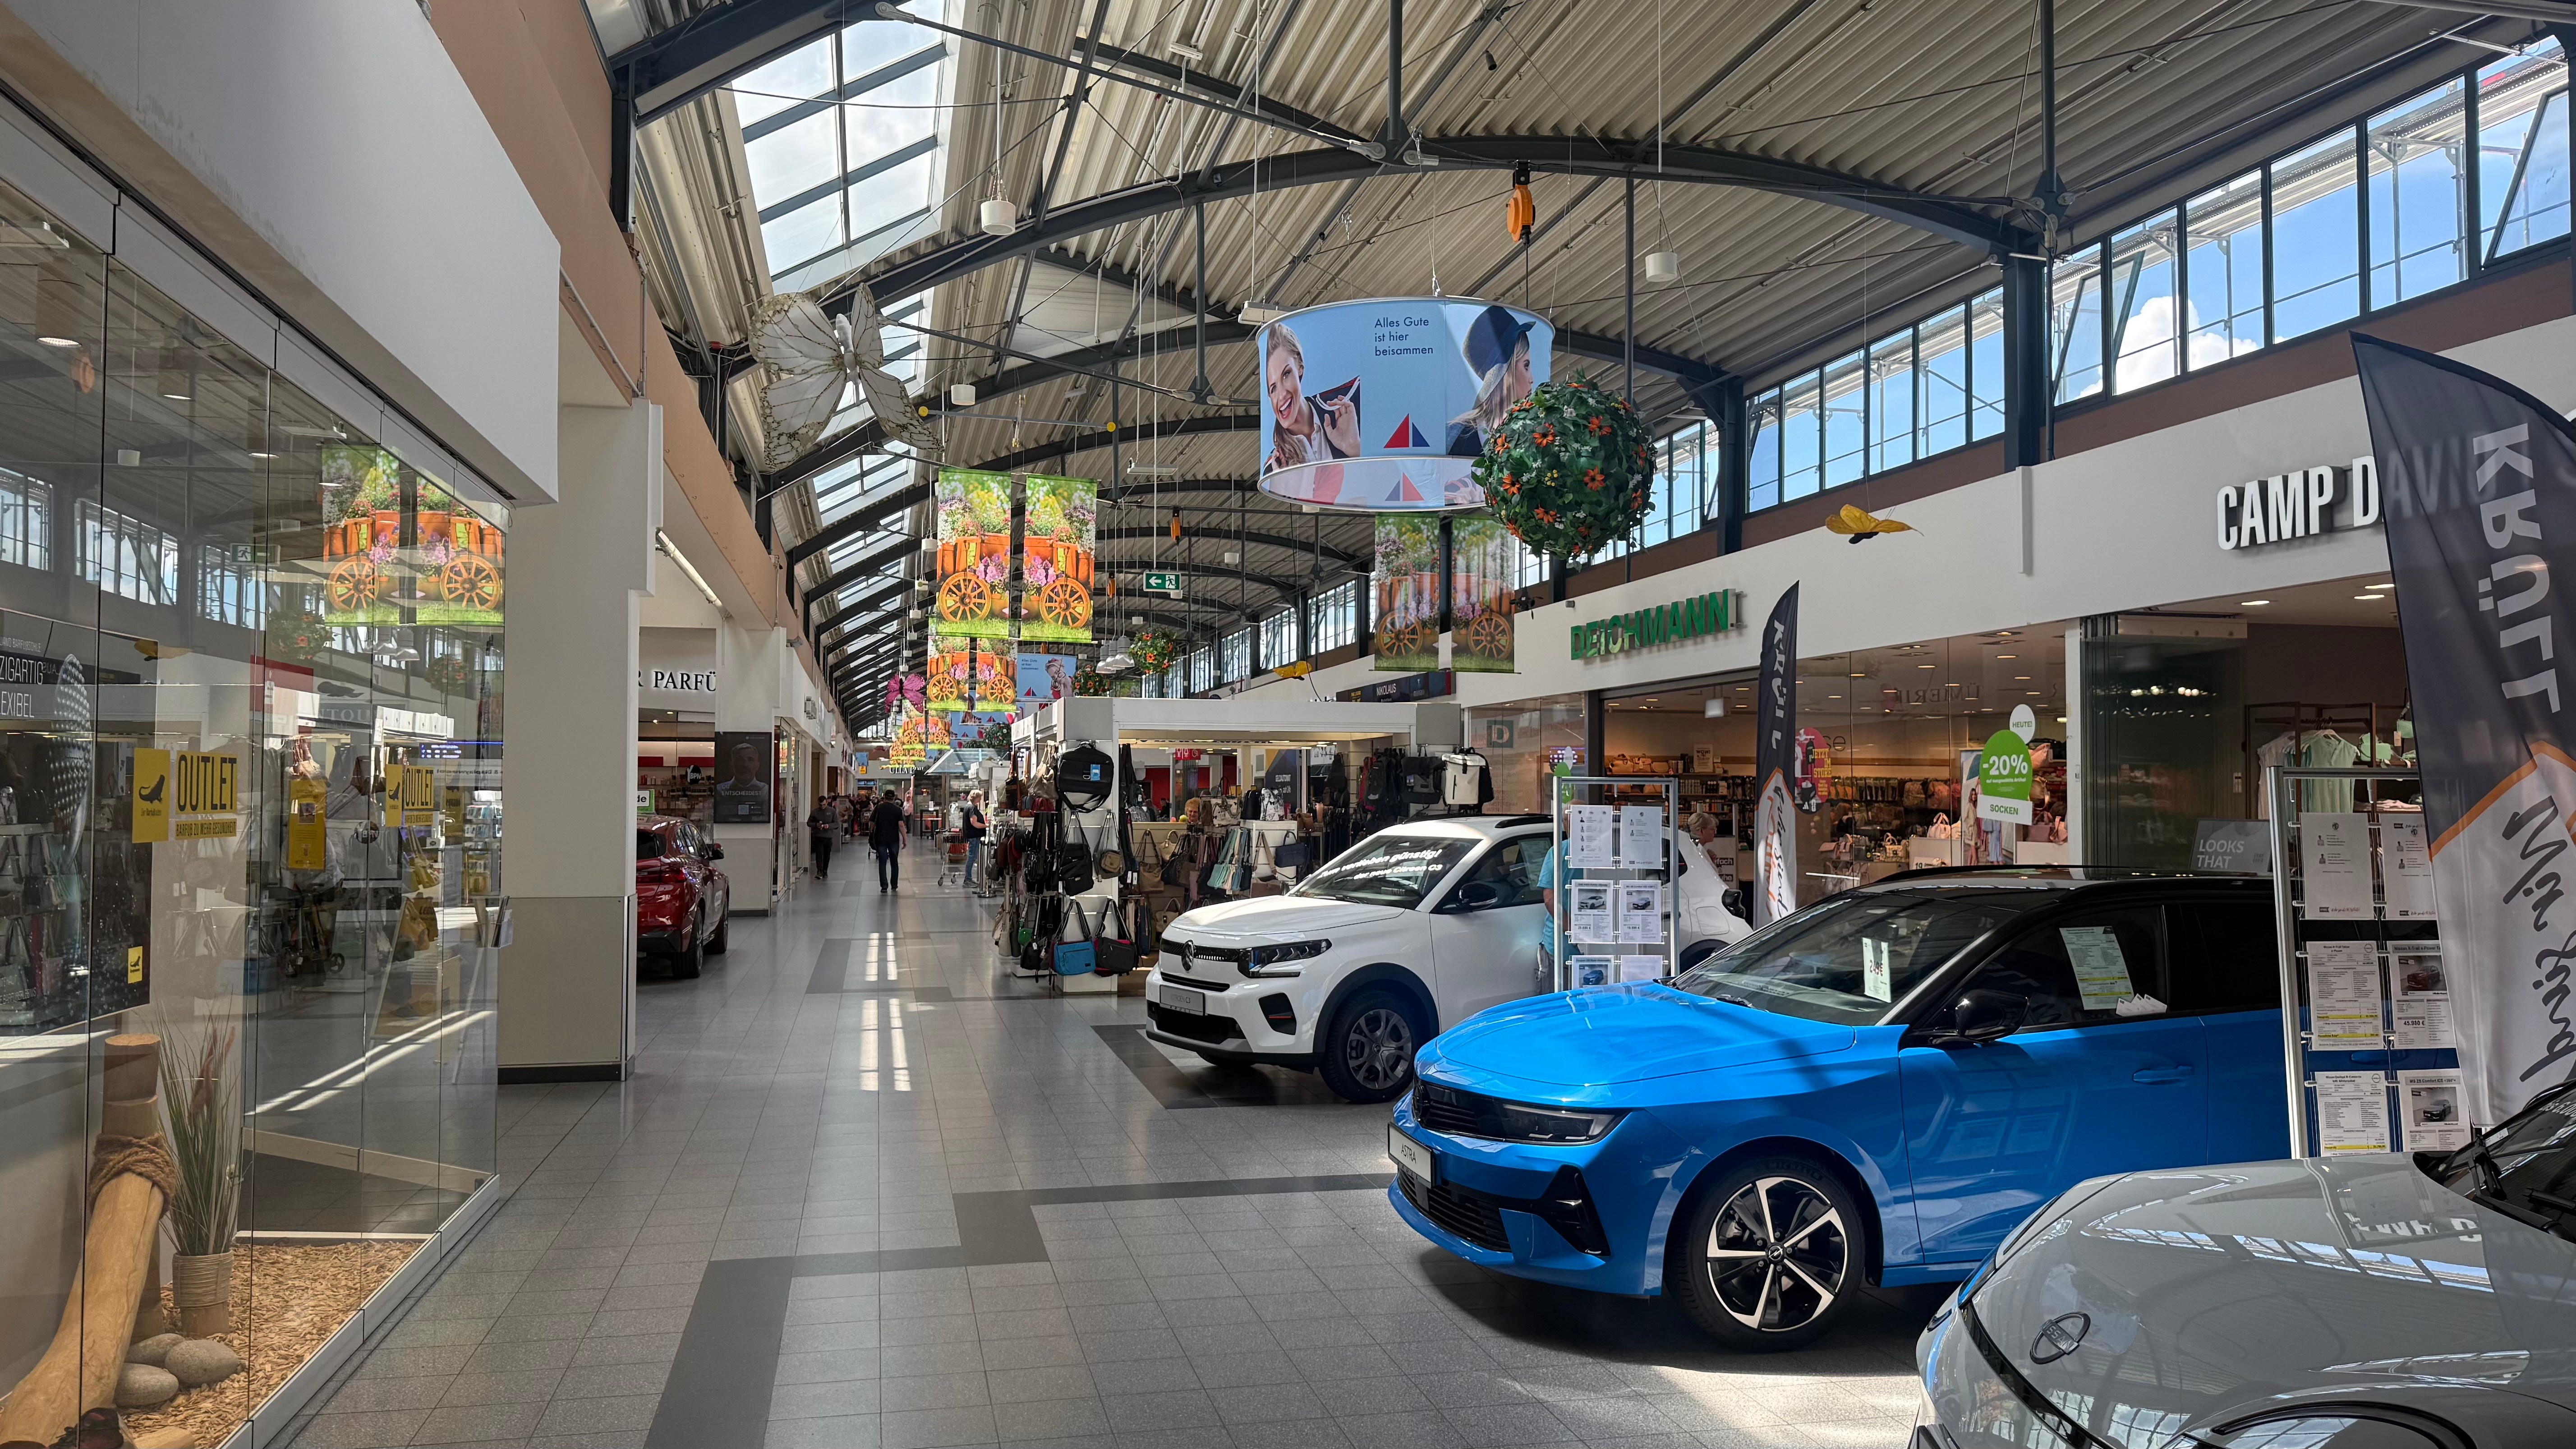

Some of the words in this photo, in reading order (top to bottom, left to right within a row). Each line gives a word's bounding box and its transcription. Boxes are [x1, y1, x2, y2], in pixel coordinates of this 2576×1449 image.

[1375, 317, 1399, 328] Alles
[1403, 317, 1429, 327] Gute
[1375, 331, 1386, 342] ist
[1389, 331, 1409, 342] hier
[1375, 345, 1433, 356] beisammen
[2217, 465, 2335, 551] CAMP
[1571, 589, 1730, 660] DEICHMANN
[1376, 683, 1396, 696] NIKOLAUS
[0, 691, 34, 718] EXIBEL
[1811, 748, 1829, 759] JETZT
[1824, 758, 1831, 768] IM
[1983, 754, 2028, 775] -20%
[1813, 768, 1832, 777] STORE
[178, 754, 237, 812] OUTLET
[405, 768, 434, 806] OUTLET
[1990, 804, 2019, 815] SOCKEN
[2199, 839, 2245, 853] LOOKS
[2197, 855, 2232, 869] THAT
[1401, 1143, 1417, 1164] ASTRA
